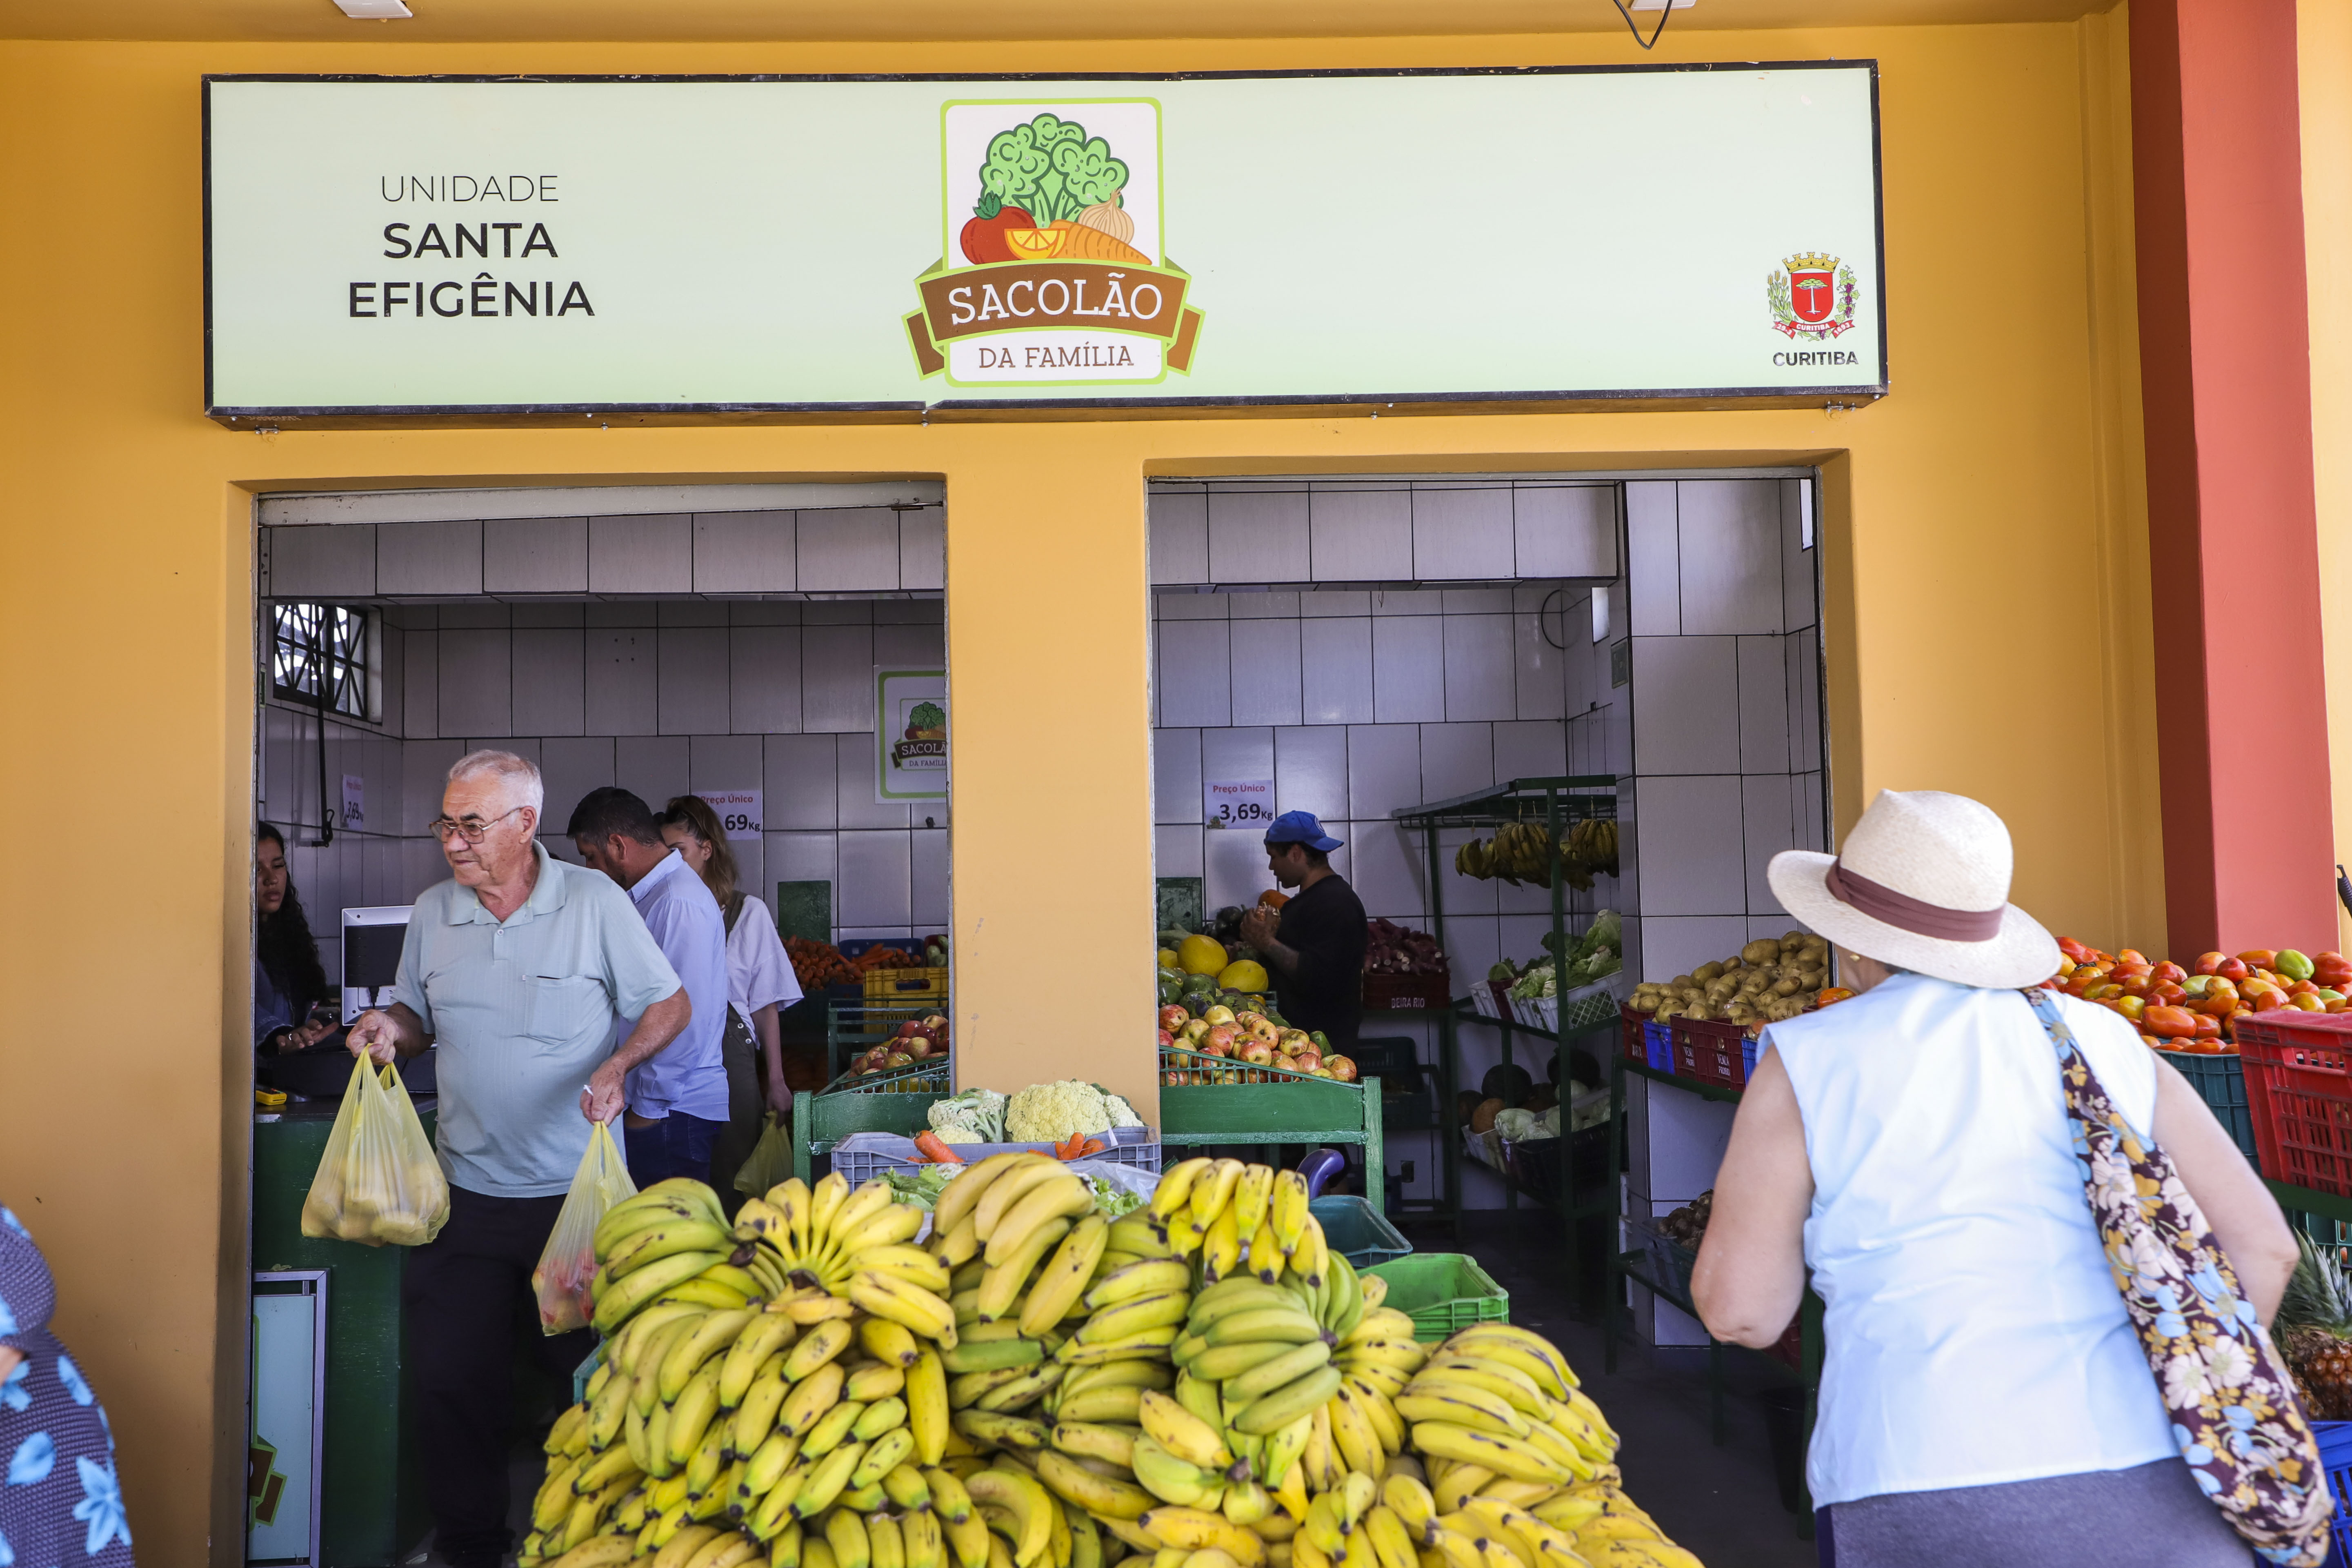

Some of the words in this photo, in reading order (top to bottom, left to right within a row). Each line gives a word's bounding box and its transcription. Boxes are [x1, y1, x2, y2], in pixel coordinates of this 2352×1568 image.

[382, 175, 559, 202] UNIDADE
[383, 222, 559, 259] SANTA
[350, 272, 595, 317] EFIGÊNIA
[948, 272, 1163, 325] SACOLÃO
[1776, 324, 1792, 335] 29-3
[1834, 322, 1850, 335] 1693
[979, 348, 1016, 368] DA
[1025, 341, 1134, 368] FAMÍLIA
[1773, 351, 1859, 366] CURITIBA
[901, 742, 946, 755] SACOLÃ
[1213, 785, 1238, 794] Preço
[1240, 783, 1265, 792] Único
[728, 794, 754, 803] Único
[1391, 997, 1412, 1008] BEIRA
[1413, 997, 1425, 1008] RIO
